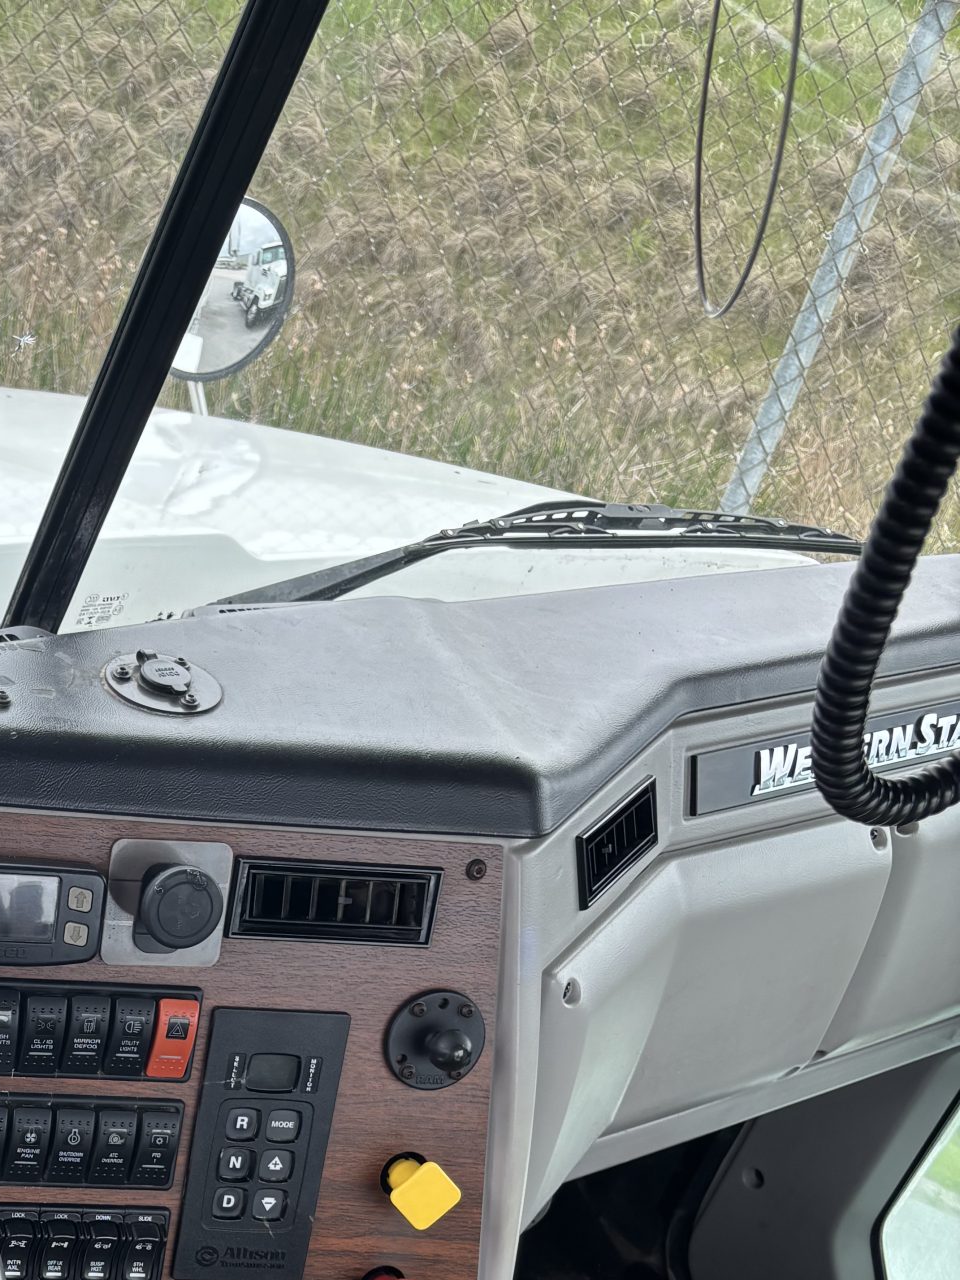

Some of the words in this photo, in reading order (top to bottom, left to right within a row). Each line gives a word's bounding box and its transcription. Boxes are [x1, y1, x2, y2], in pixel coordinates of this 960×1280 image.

[755, 724, 914, 792] WERN
[305, 1058, 317, 1092] MONITOR
[236, 1116, 249, 1129] R
[271, 1120, 295, 1129] MODE
[229, 1156, 242, 1168] N
[222, 1196, 235, 1208] D
[223, 1246, 286, 1260] Allison
